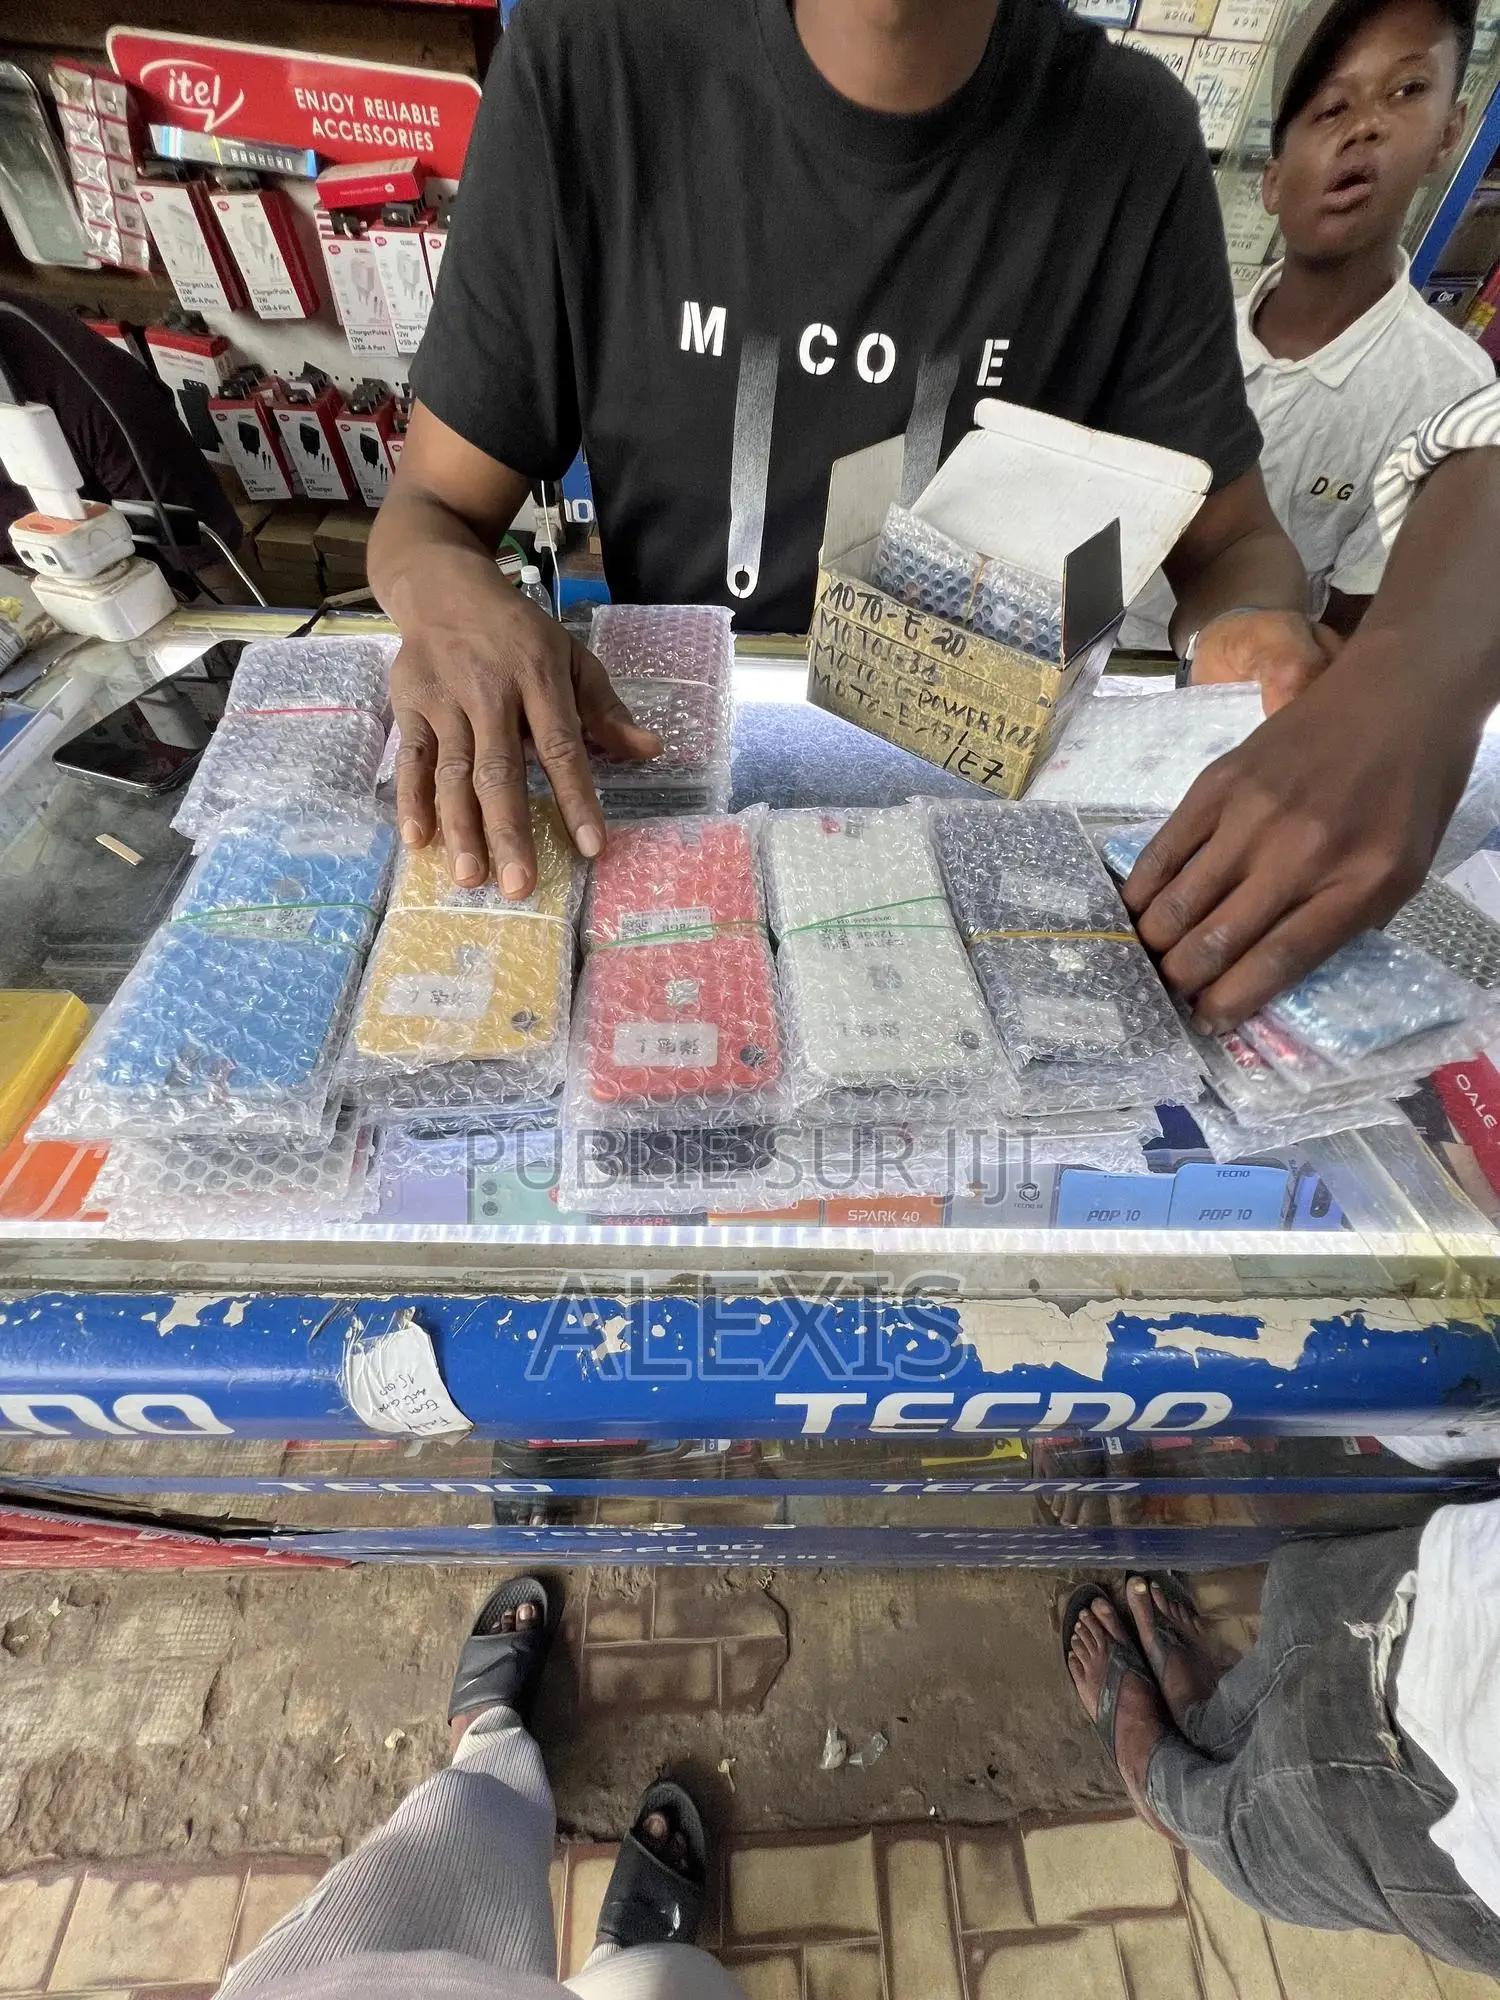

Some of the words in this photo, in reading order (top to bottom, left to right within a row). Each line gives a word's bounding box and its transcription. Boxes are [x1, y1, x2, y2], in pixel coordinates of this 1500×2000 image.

[168, 69, 221, 106] itel
[294, 87, 355, 116] ENJOY
[363, 96, 441, 128] RELIABLE
[312, 116, 435, 152] ACCESSORIES
[680, 301, 727, 357] M
[976, 339, 1010, 387] E
[1216, 1170, 1251, 1178] TECNO
[847, 1209, 897, 1222] SPARK
[902, 1210, 920, 1223] 40
[1087, 1209, 1121, 1222] POP
[1125, 1209, 1142, 1221] 10
[1199, 1208, 1234, 1221] POP
[1236, 1208, 1252, 1220] 10
[774, 1391, 1234, 1435] TECNO
[256, 1482, 555, 1493] TECNO
[869, 1482, 1142, 1493] TECNO
